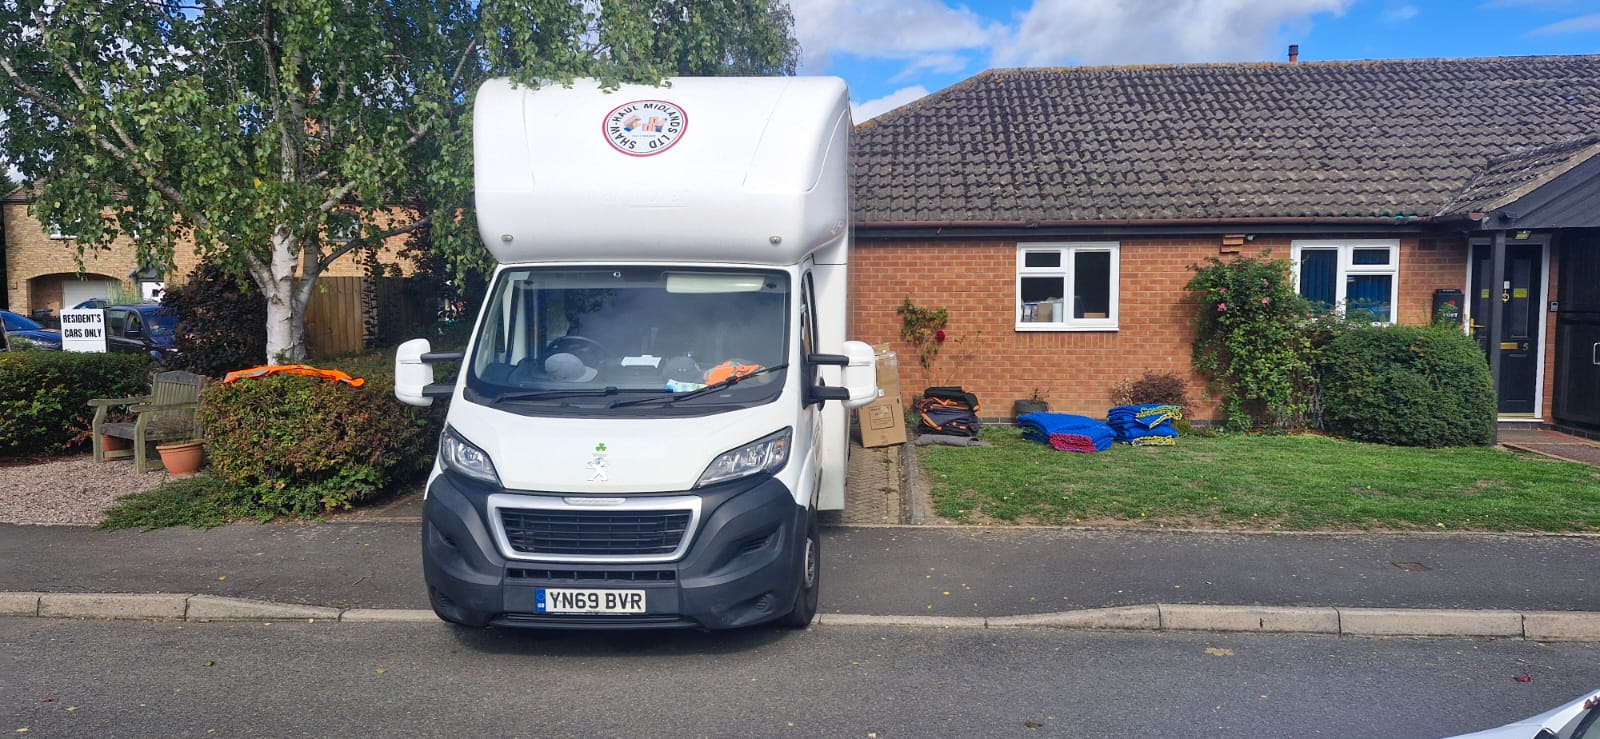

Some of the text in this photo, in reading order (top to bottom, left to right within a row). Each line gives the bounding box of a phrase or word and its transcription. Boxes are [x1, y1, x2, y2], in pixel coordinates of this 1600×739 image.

[610, 103, 680, 149] SHAW-HAUL MIDLANDS LTD
[63, 314, 101, 323] RESIDENT'S
[64, 328, 101, 337] CARS ONLY
[549, 591, 642, 610] YN69 BVR
